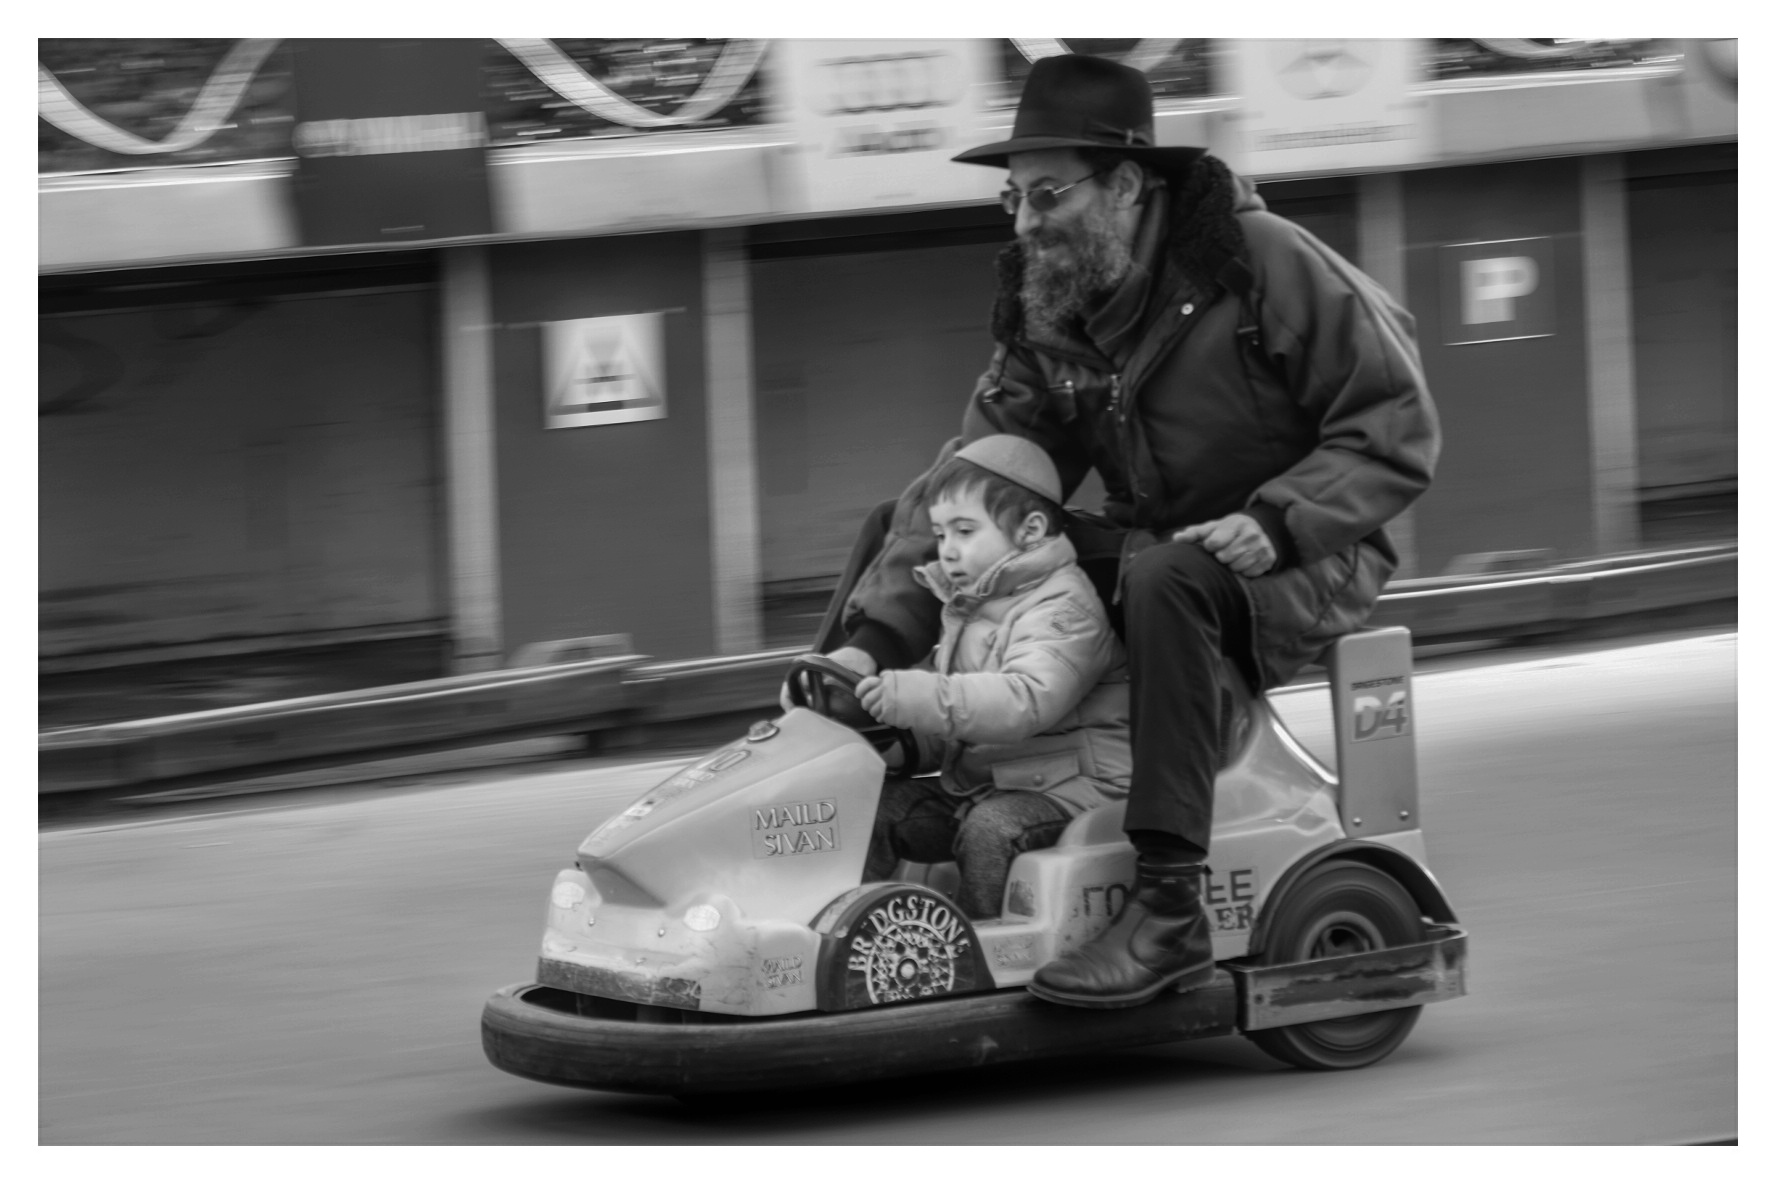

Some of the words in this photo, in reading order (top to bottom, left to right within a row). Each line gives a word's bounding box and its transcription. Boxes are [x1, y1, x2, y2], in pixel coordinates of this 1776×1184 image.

[1354, 690, 1408, 740] D4
[755, 802, 837, 831] MAILD
[764, 826, 835, 856] SIVAN
